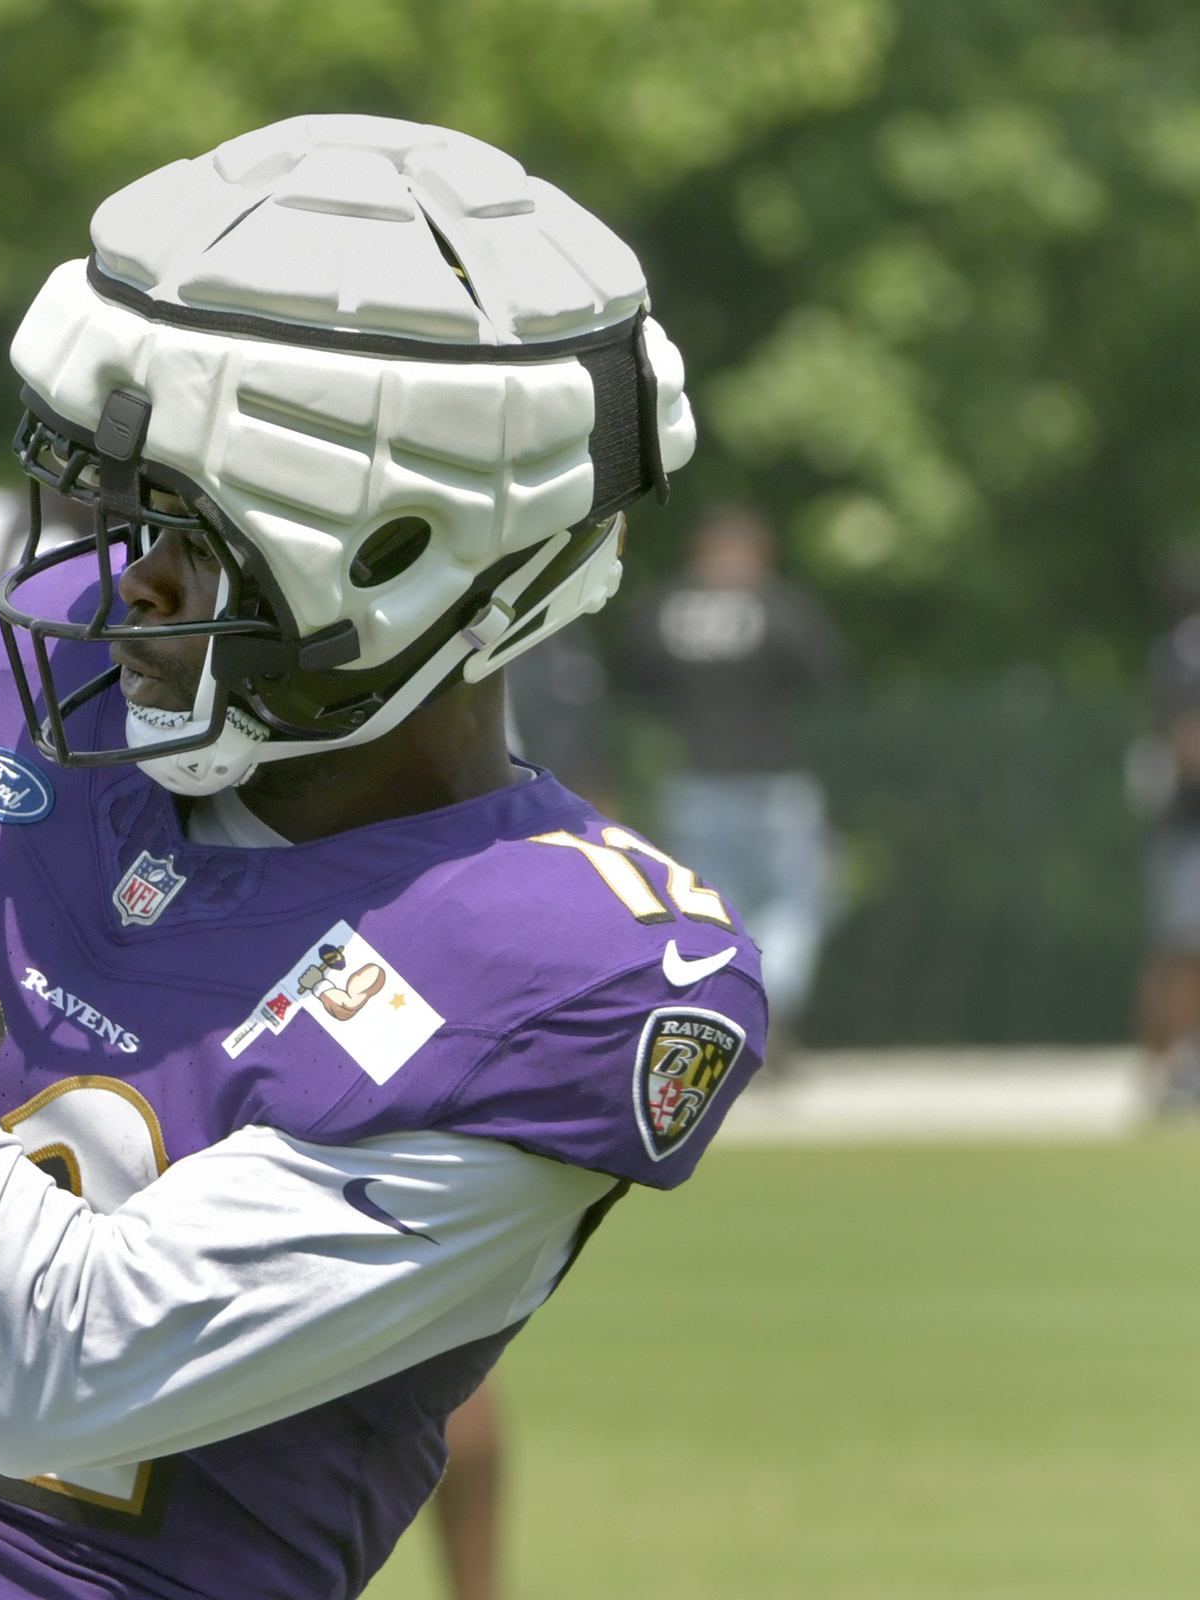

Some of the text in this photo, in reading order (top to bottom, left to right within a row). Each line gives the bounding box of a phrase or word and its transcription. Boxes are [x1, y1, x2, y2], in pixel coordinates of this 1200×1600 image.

[121, 877, 159, 915] NFL
[527, 827, 738, 936] 12
[21, 967, 140, 1054] RAVENS
[661, 1020, 735, 1051] RAVENS
